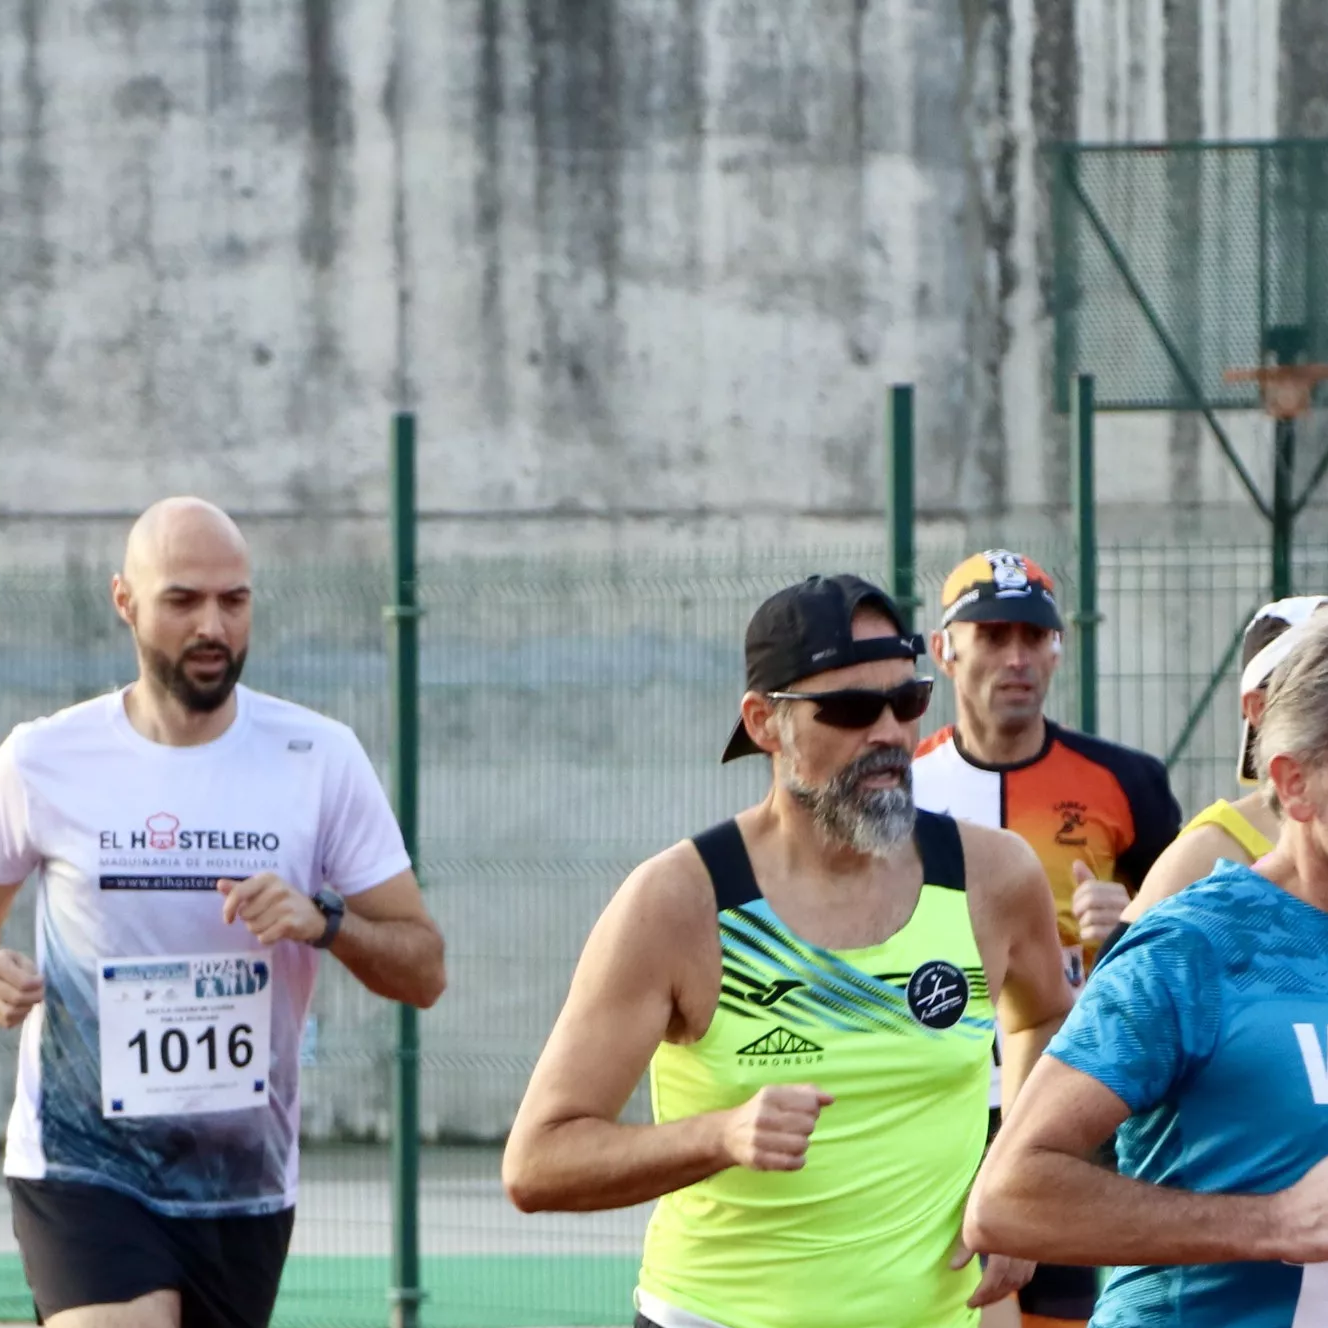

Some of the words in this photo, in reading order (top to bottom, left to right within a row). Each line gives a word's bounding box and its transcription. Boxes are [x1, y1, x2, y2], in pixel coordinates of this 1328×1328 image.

[99, 830, 123, 850] EL
[99, 856, 181, 867] MAQUINARIA
[185, 857, 201, 868] DE
[116, 876, 216, 888] www.elhostele
[128, 1023, 254, 1074] 1016
[737, 1055, 824, 1067] ESMONSUR
